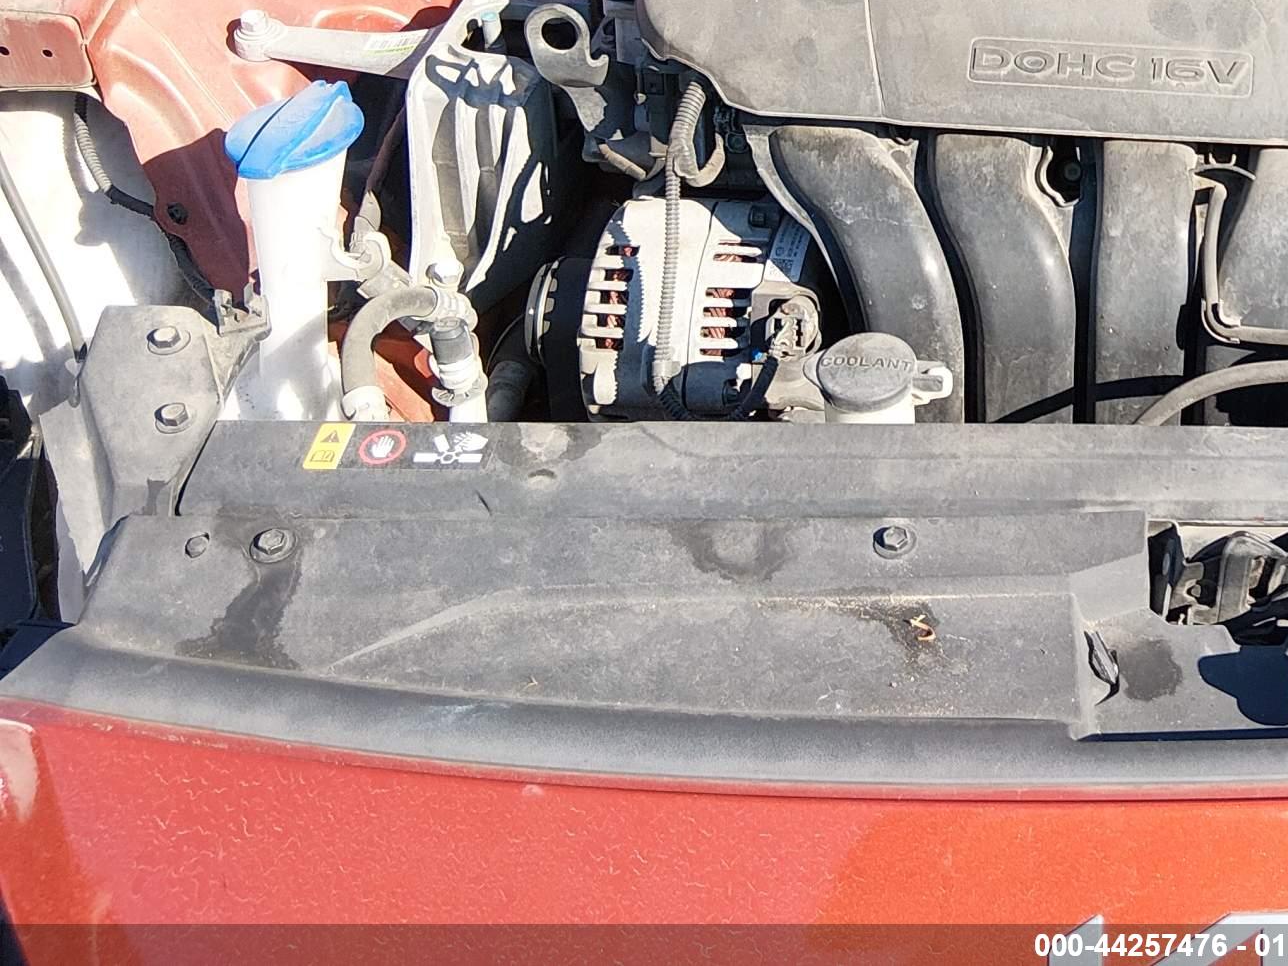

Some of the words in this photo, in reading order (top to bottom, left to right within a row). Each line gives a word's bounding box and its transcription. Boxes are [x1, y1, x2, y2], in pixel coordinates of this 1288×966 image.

[972, 46, 1136, 82] DOHC
[1150, 56, 1249, 86] 16V
[820, 354, 913, 372] COOLANT
